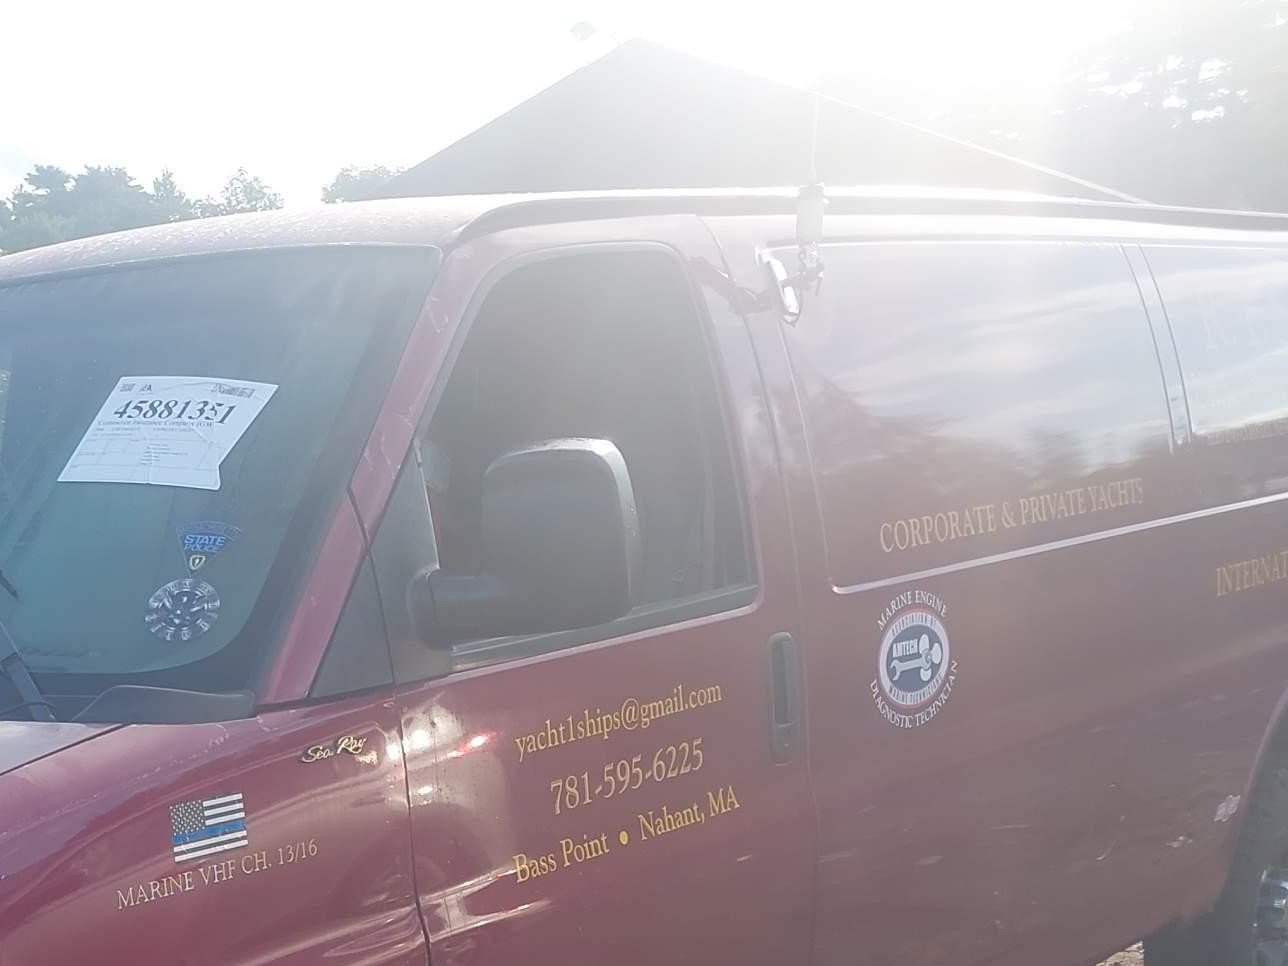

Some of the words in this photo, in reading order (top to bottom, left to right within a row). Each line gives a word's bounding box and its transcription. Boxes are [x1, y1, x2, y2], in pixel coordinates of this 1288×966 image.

[114, 399, 236, 424] 45881351
[184, 534, 226, 546] STATE
[879, 504, 998, 553] CORPORATE
[1001, 501, 1016, 529] &
[1018, 487, 1086, 526] PRIVATE
[1087, 478, 1145, 514] YACHTS
[876, 590, 913, 631] MARINE
[914, 590, 948, 618] ENGINE
[514, 683, 722, 762] yacht1ships@gmail.com
[869, 678, 914, 729] DIAGNOSTIC
[915, 659, 959, 728] TECHNICIAN
[336, 734, 368, 755] Ray
[550, 737, 704, 816] 781-595-6225
[512, 853, 557, 884] Bass
[560, 832, 610, 868] Point
[637, 802, 705, 841] Nahant,
[706, 786, 741, 817] MA
[116, 871, 195, 911] MARINE
[198, 857, 237, 888] VHF
[240, 851, 272, 876] CH.
[277, 839, 319, 868] 13/16
